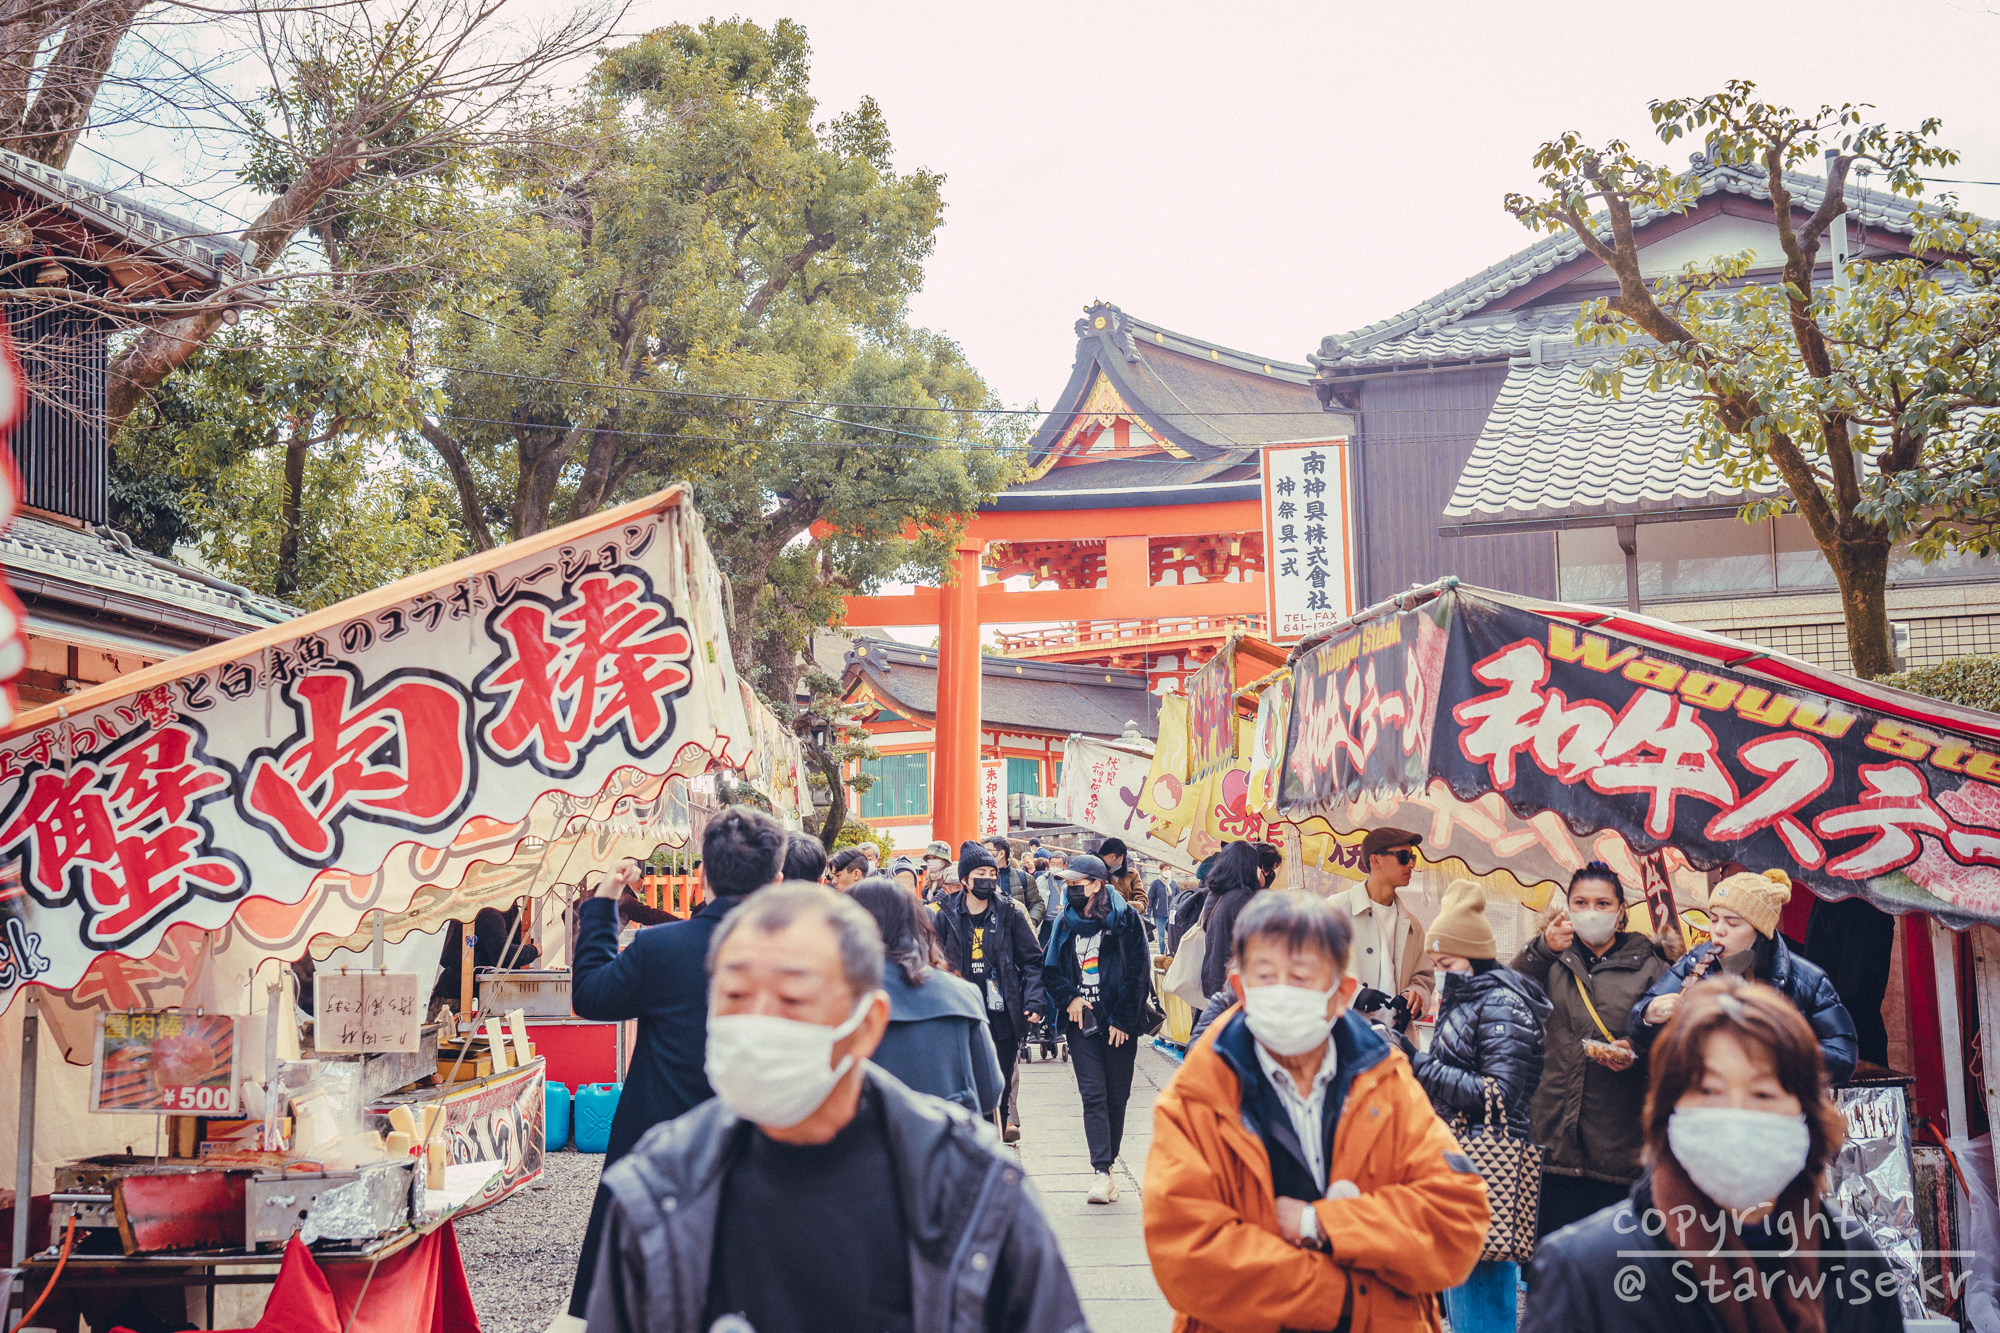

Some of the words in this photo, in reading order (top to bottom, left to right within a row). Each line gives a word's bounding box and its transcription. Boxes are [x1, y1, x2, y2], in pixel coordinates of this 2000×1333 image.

[1276, 475, 1299, 577] 神祭具一式
[1301, 450, 1332, 611] 南神具株式會社
[1315, 632, 1361, 678] Wagyu
[1361, 614, 1402, 657] Steak
[1547, 622, 1857, 739] Wagyu
[985, 767, 998, 836] 朱印授与所
